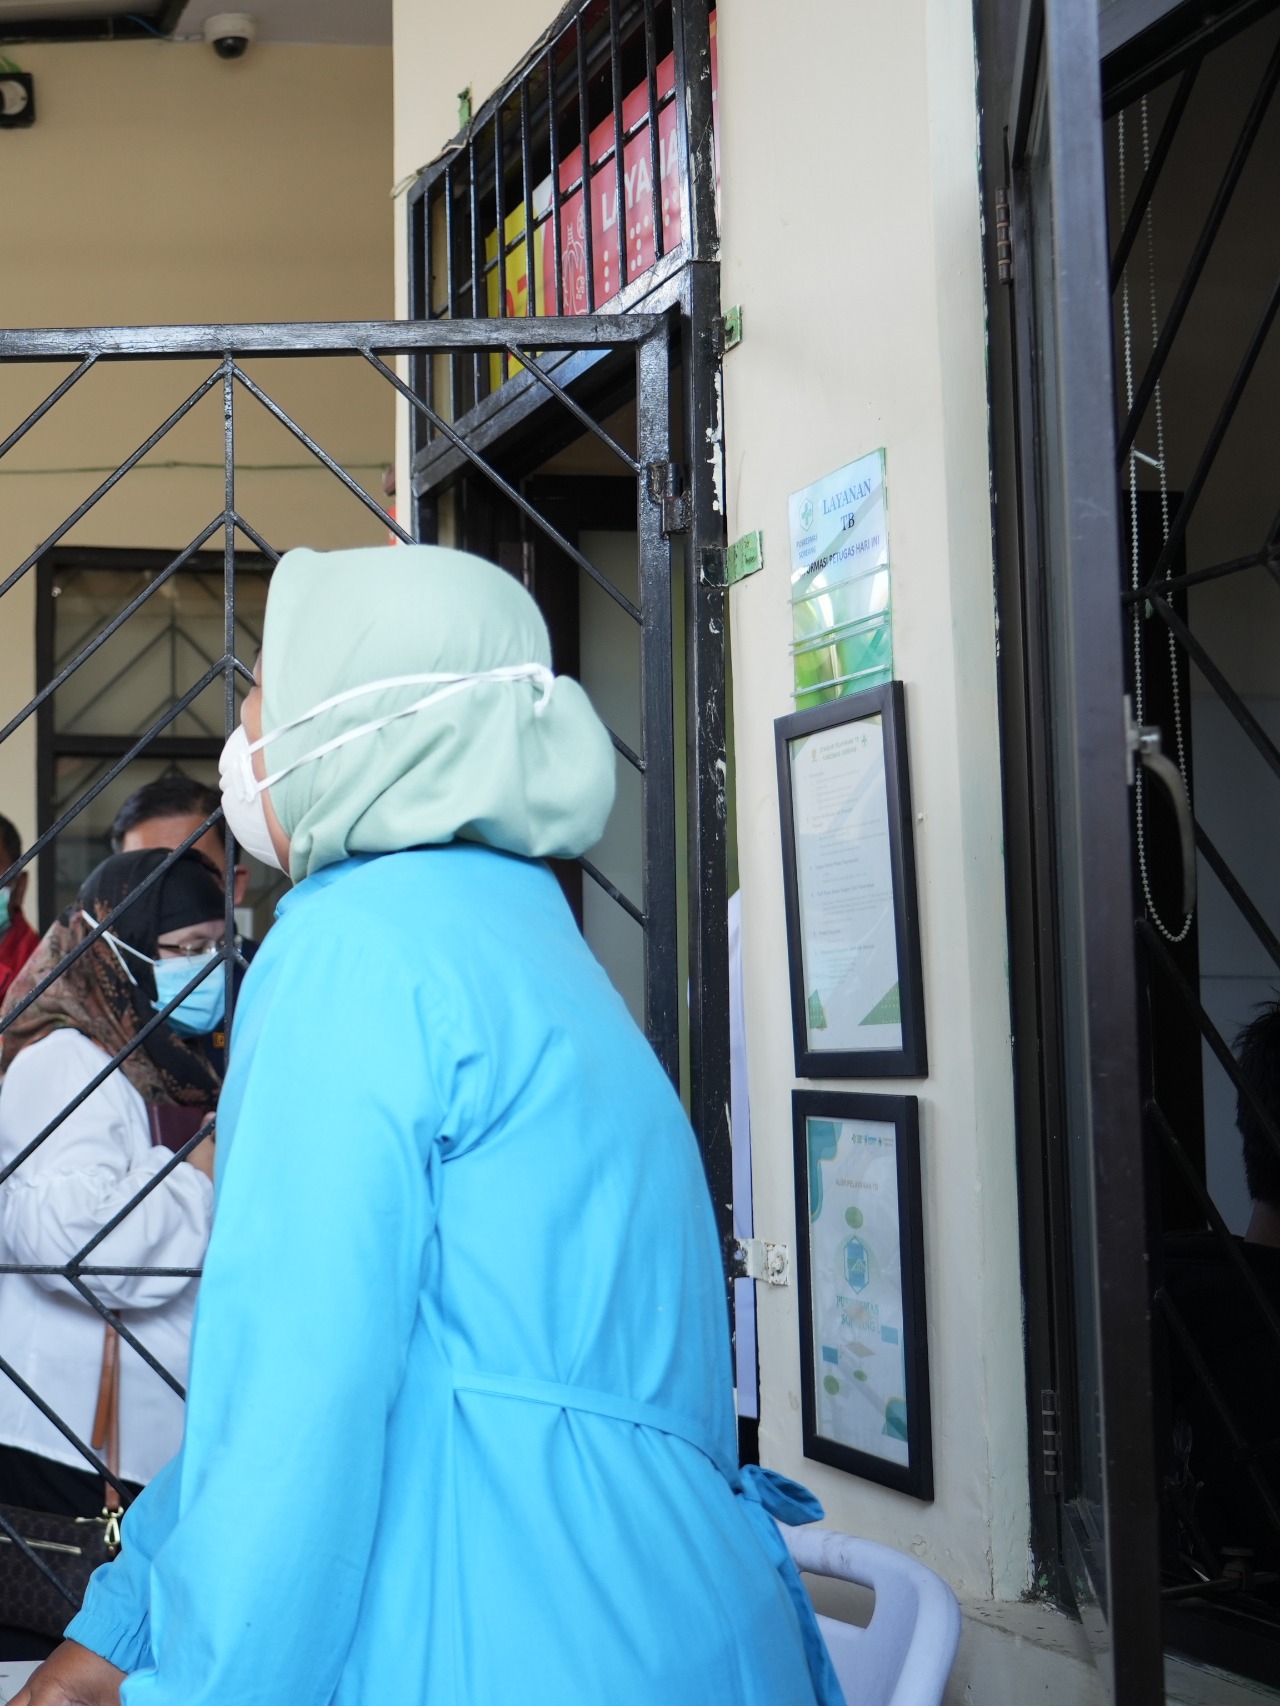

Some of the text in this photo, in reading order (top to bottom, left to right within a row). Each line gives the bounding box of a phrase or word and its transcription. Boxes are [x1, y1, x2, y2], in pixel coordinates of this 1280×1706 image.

[822, 478, 871, 515] LAYANAN
[840, 512, 855, 531] TB
[828, 545, 855, 565] PETUGAS
[855, 538, 870, 555] HARI
[871, 534, 880, 549] INI
